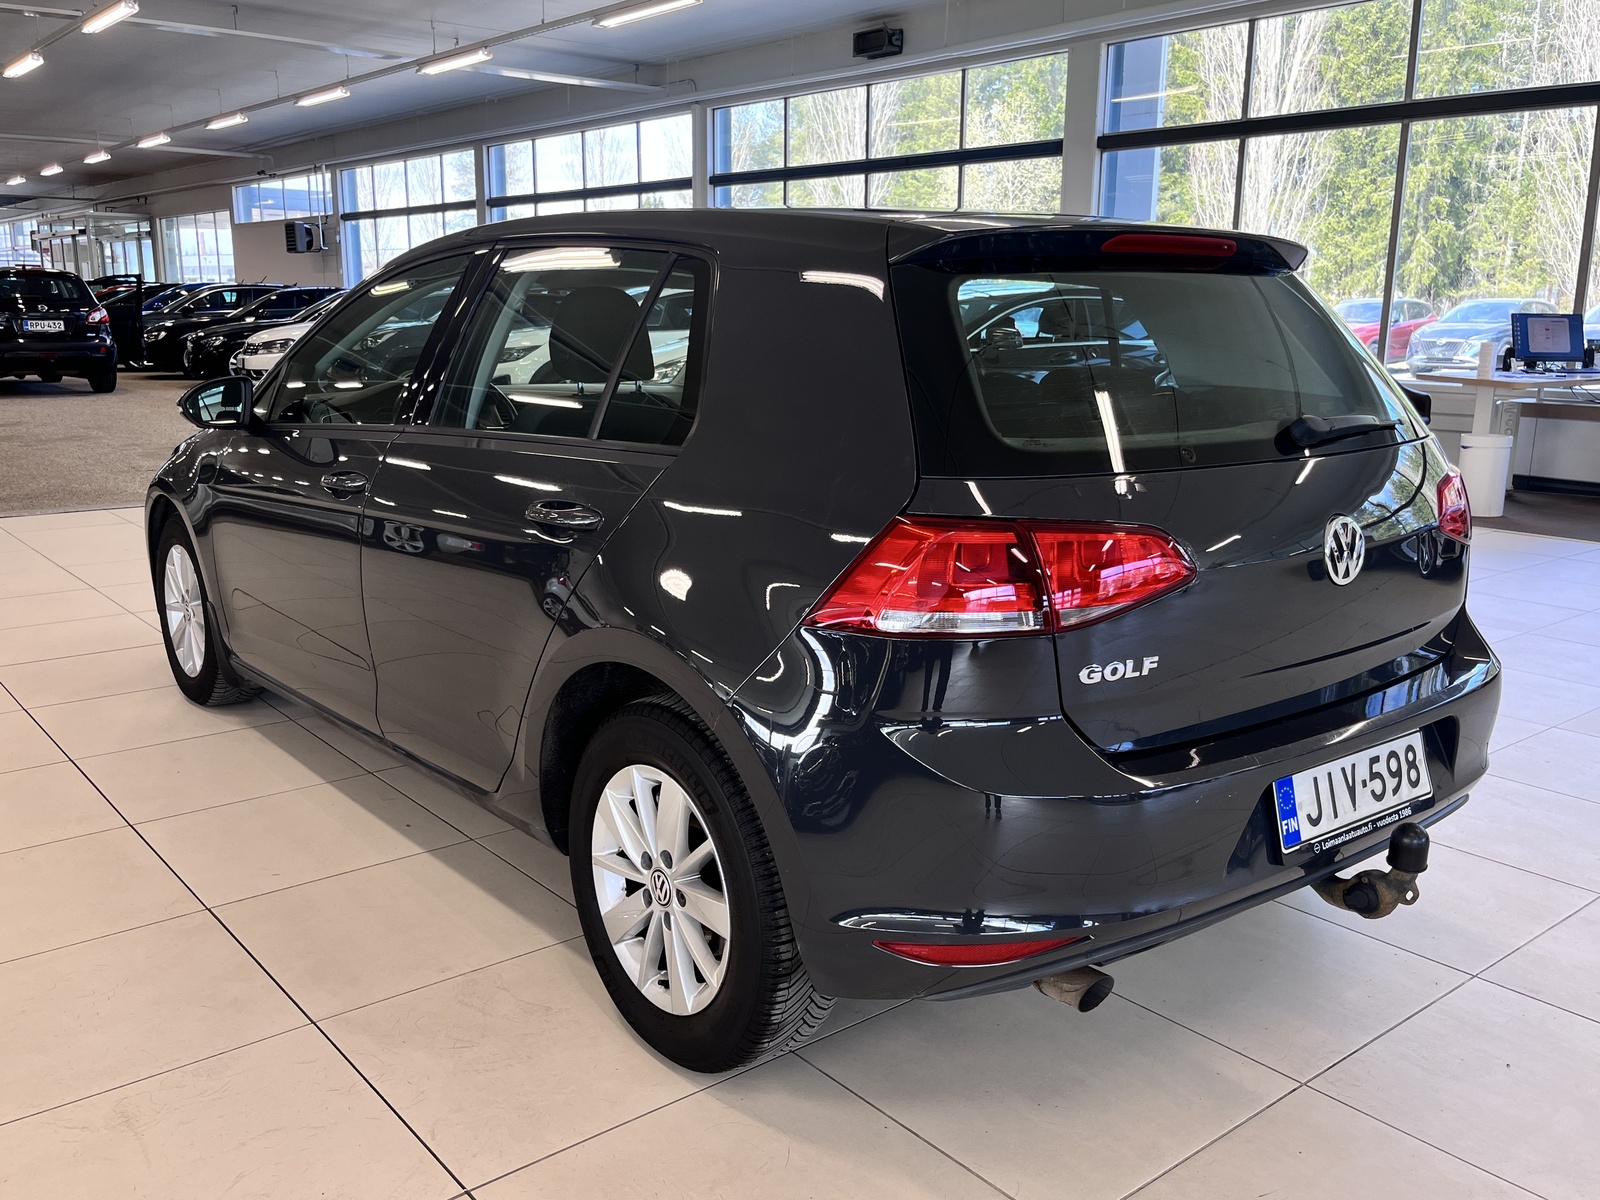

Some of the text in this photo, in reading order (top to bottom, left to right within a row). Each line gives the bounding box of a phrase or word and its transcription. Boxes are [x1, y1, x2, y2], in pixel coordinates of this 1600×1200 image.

[29, 321, 62, 329] RPU-432
[1078, 655, 1159, 685] GOLF
[1306, 744, 1420, 827] JIV-598
[1281, 816, 1300, 836] FIN
[1321, 822, 1373, 850] Loimaanlaatuauto.fi
[1376, 813, 1399, 828] vuodesta
